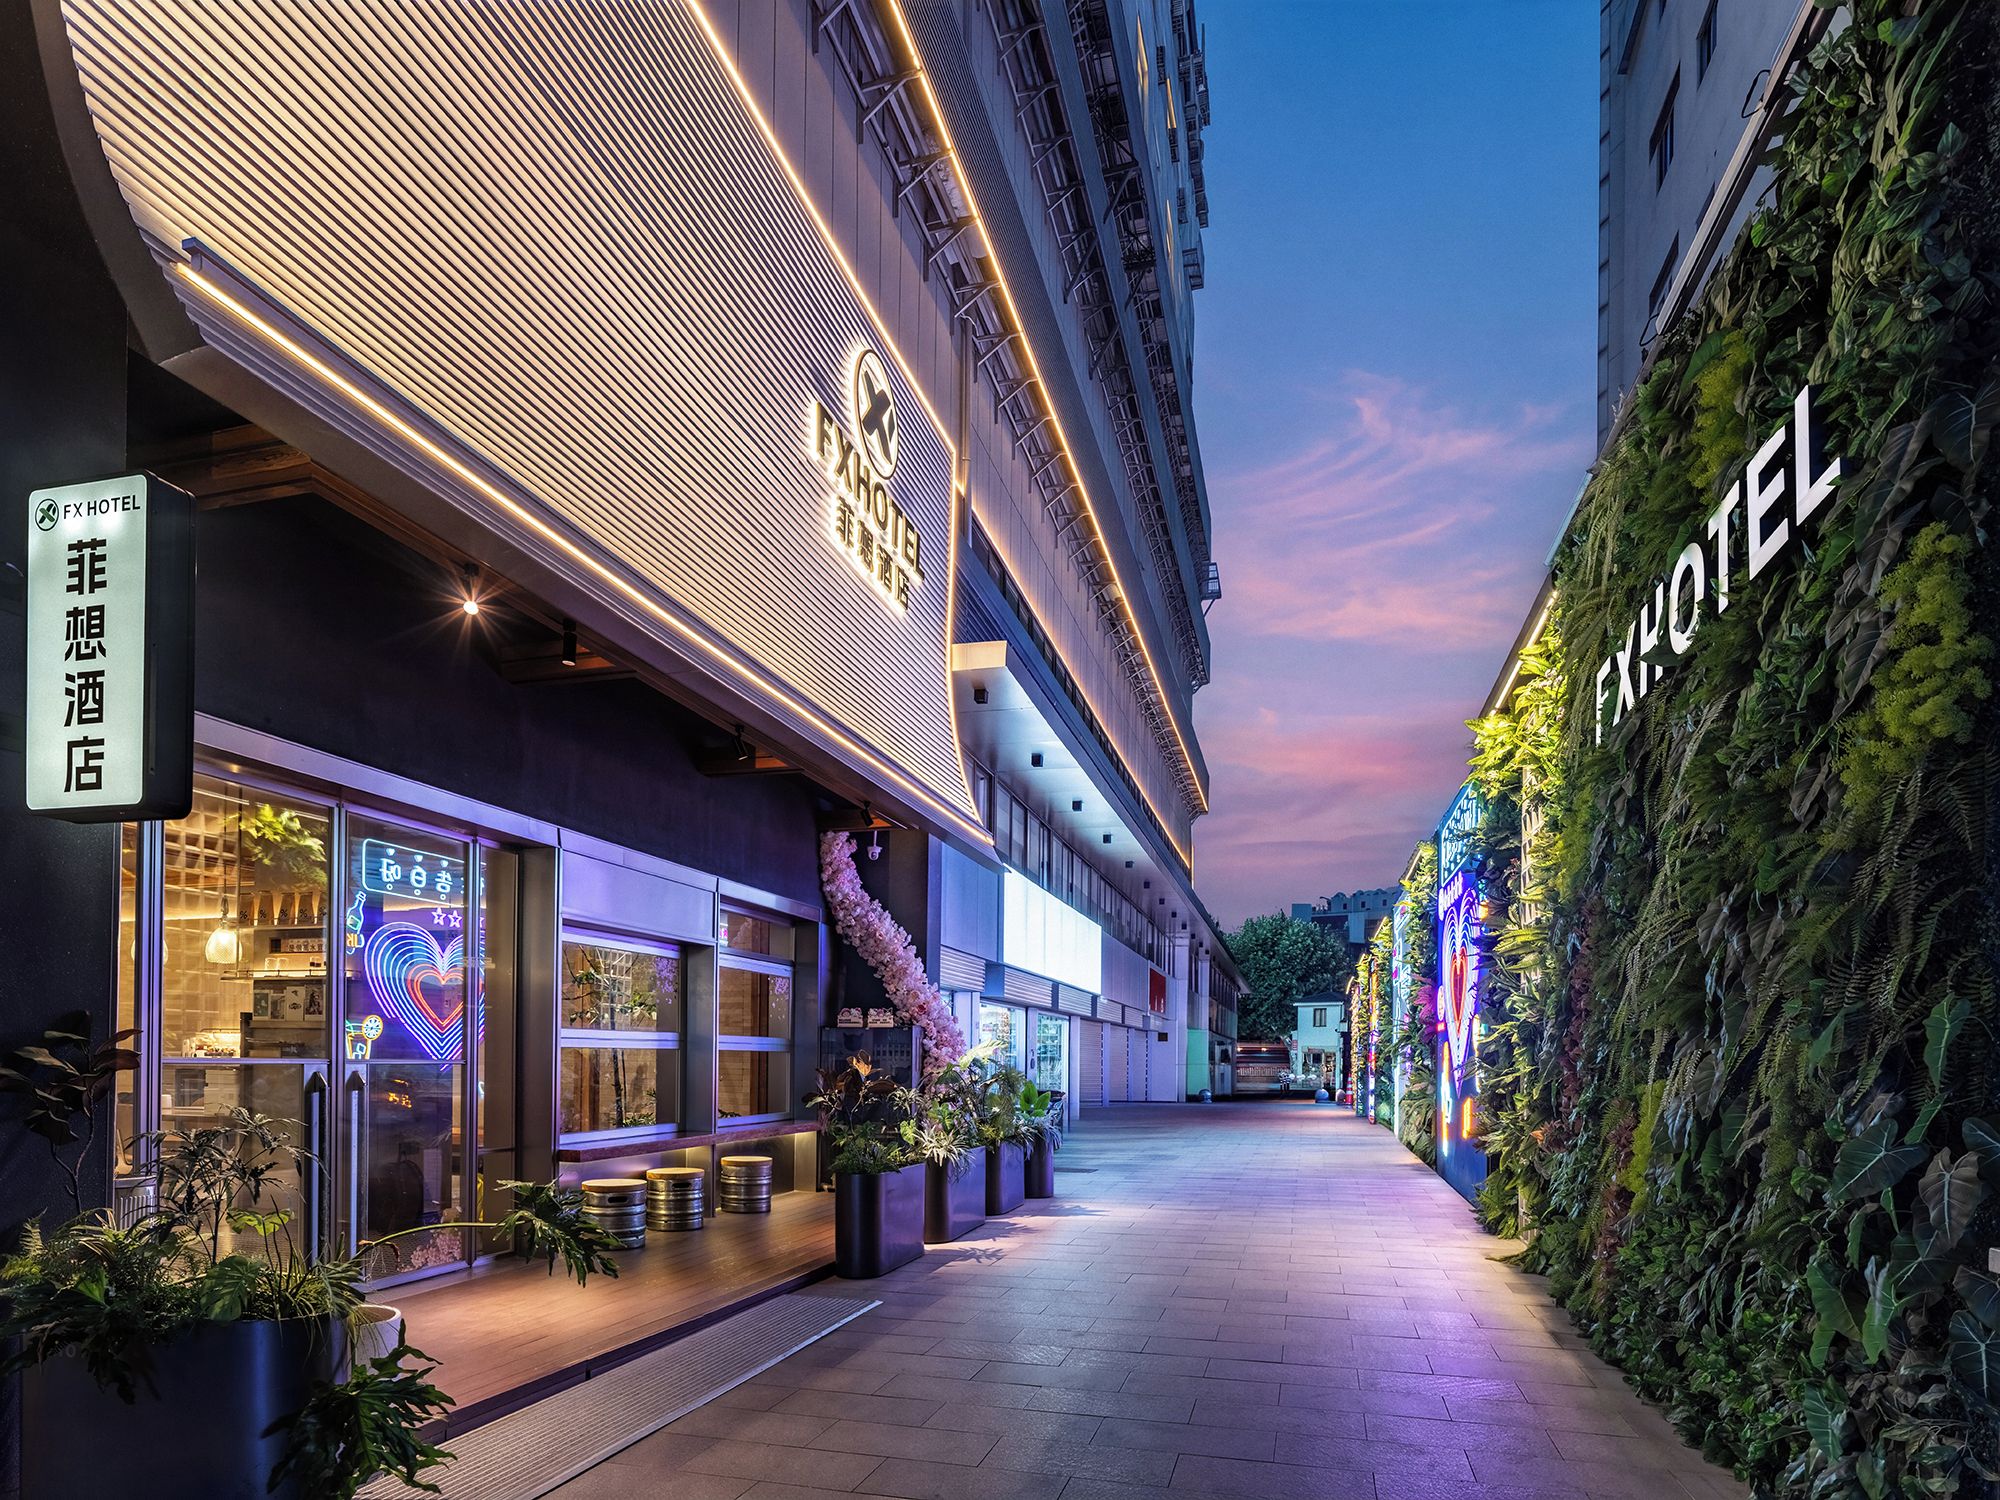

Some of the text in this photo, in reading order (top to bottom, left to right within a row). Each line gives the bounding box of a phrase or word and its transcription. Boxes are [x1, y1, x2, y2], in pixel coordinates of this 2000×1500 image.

[63, 494, 141, 519] FX HOTEL
[836, 496, 910, 611] 菲想酒店
[63, 537, 108, 793] 菲想酒店
